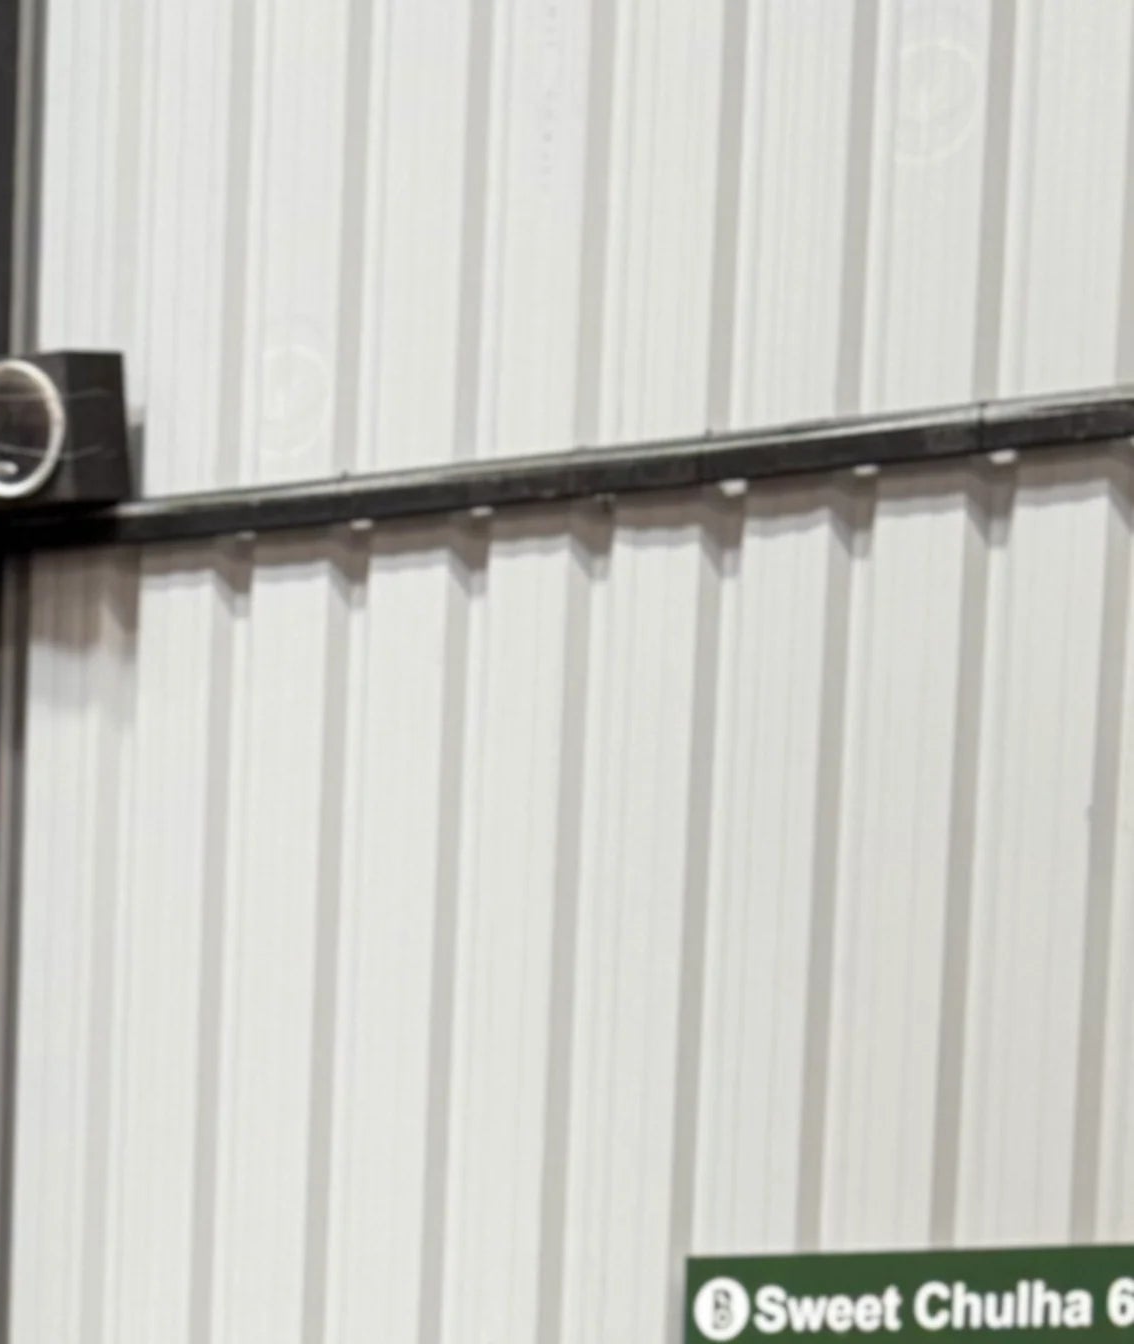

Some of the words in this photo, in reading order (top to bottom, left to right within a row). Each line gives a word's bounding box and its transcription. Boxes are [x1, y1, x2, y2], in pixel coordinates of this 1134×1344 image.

[754, 1284, 902, 1334] Sweet
[914, 1279, 1094, 1331] Chulha
[1107, 1276, 1134, 1328] 6
